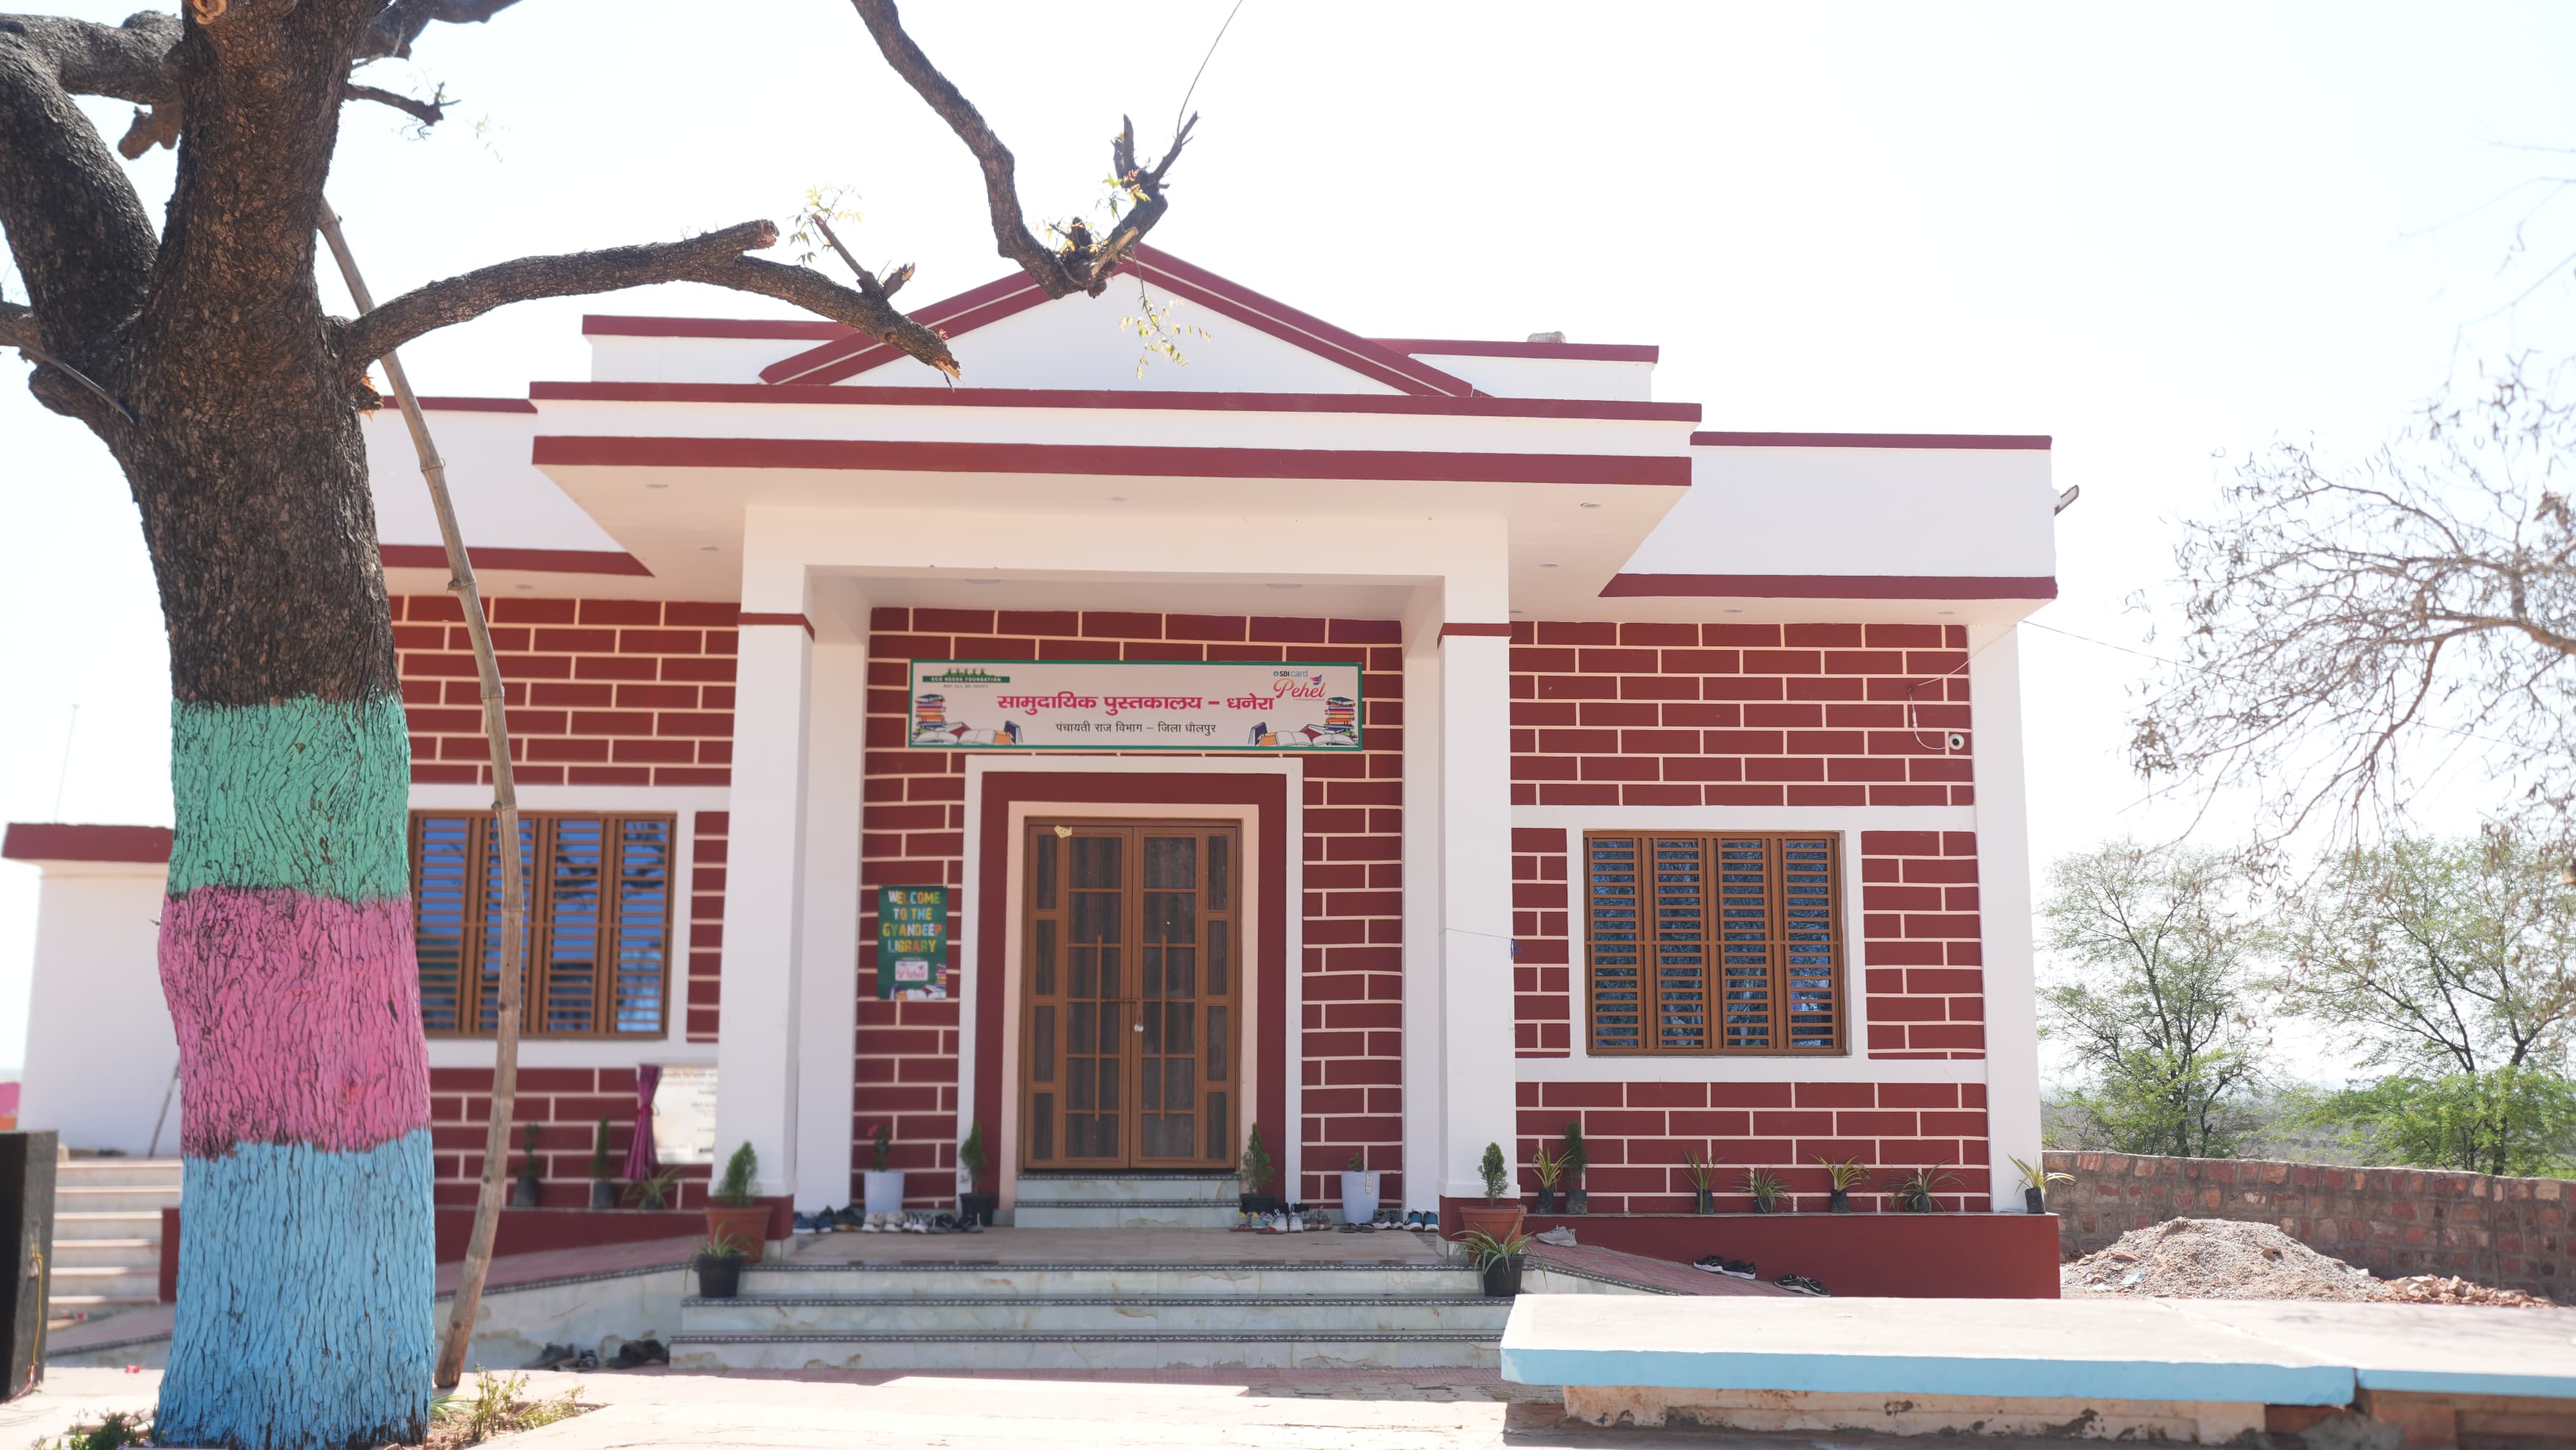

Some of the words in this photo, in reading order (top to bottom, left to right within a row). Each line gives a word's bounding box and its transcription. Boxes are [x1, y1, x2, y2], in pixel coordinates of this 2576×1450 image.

[1273, 678, 1326, 699] Pehel
[997, 691, 1098, 715] सामुदायिक
[1103, 696, 1203, 716] पुस्तकालय
[1227, 693, 1275, 710] धनेरा
[1056, 721, 1091, 732] पंचायती
[1094, 723, 1112, 732] राज
[1116, 721, 1142, 732] विभाग
[1157, 721, 1181, 732] जिला
[888, 890, 940, 904] WELCOME
[893, 908, 907, 921] TO
[911, 908, 932, 921] THE
[882, 924, 942, 937] GYANDEEP
[887, 940, 937, 953] LIBRARY
